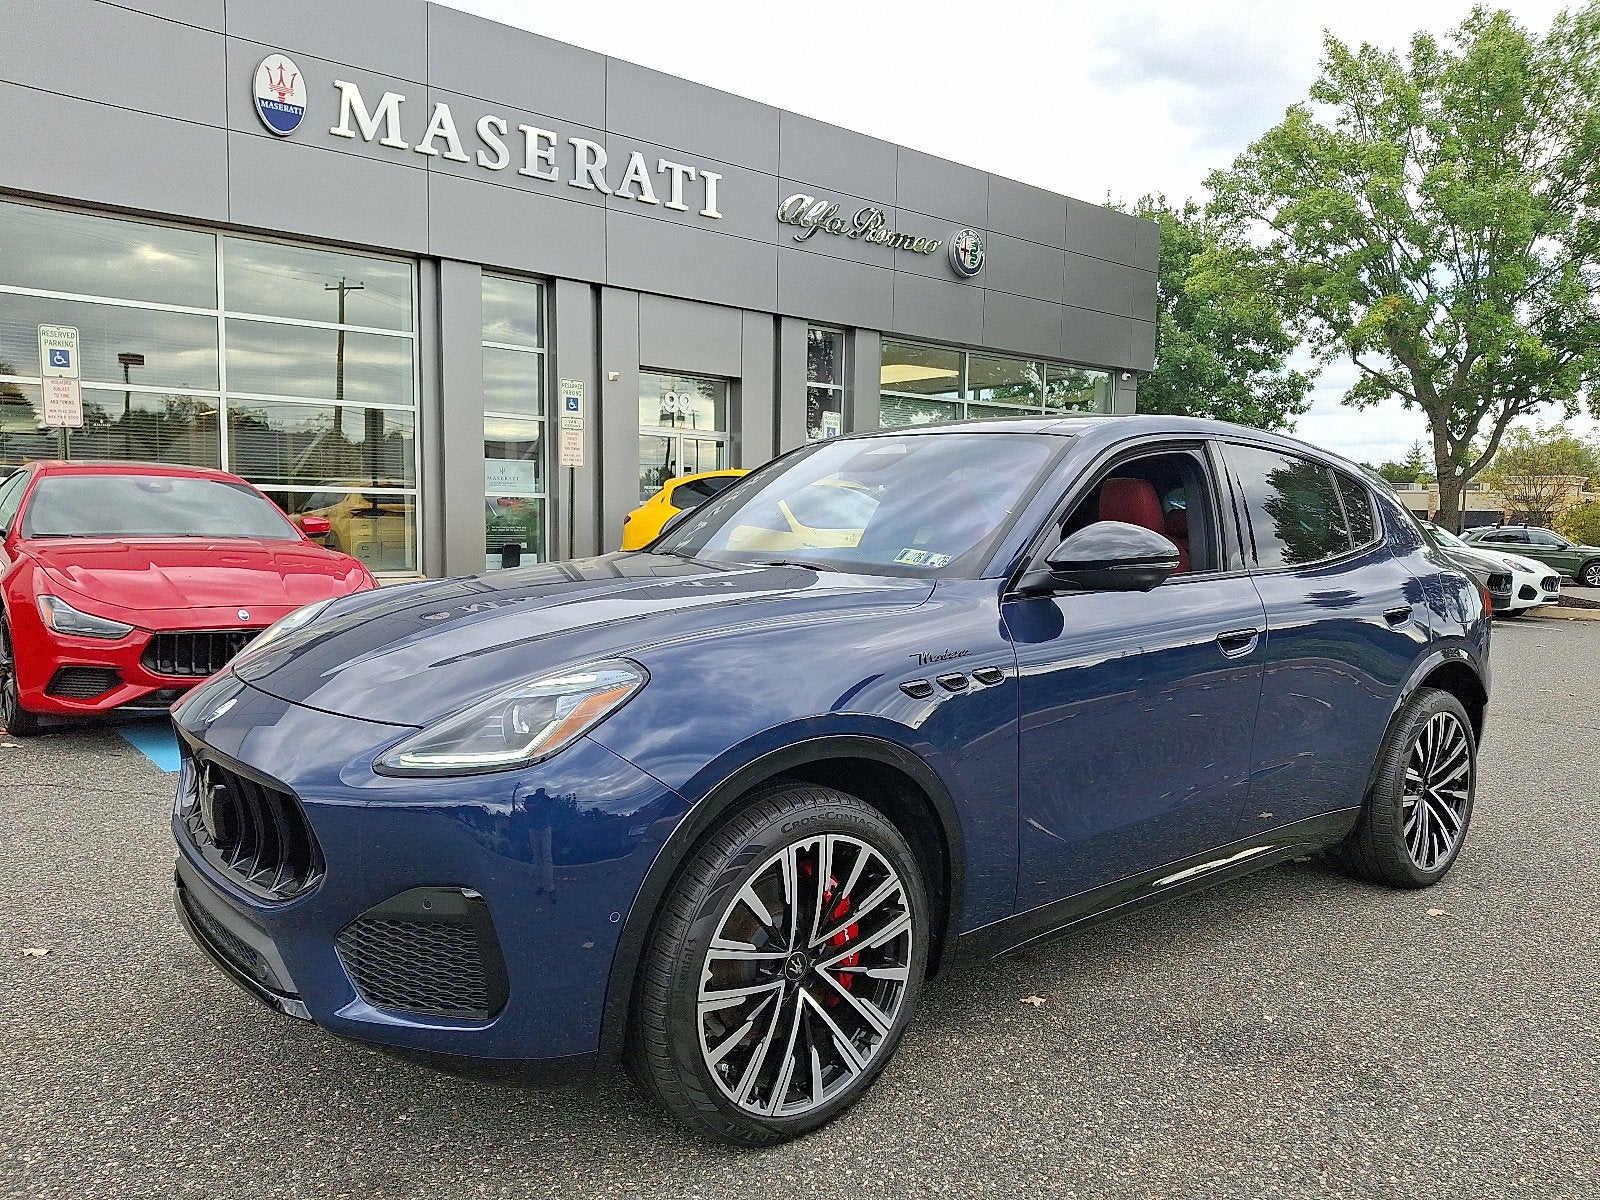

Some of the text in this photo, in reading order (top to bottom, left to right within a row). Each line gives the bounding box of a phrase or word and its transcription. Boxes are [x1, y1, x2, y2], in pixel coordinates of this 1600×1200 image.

[260, 100, 304, 116] MASERATI
[329, 79, 724, 219] MASERATI
[777, 193, 943, 255] Alfa Romeo
[41, 330, 75, 339] RESERVED
[44, 339, 74, 348] PARKING
